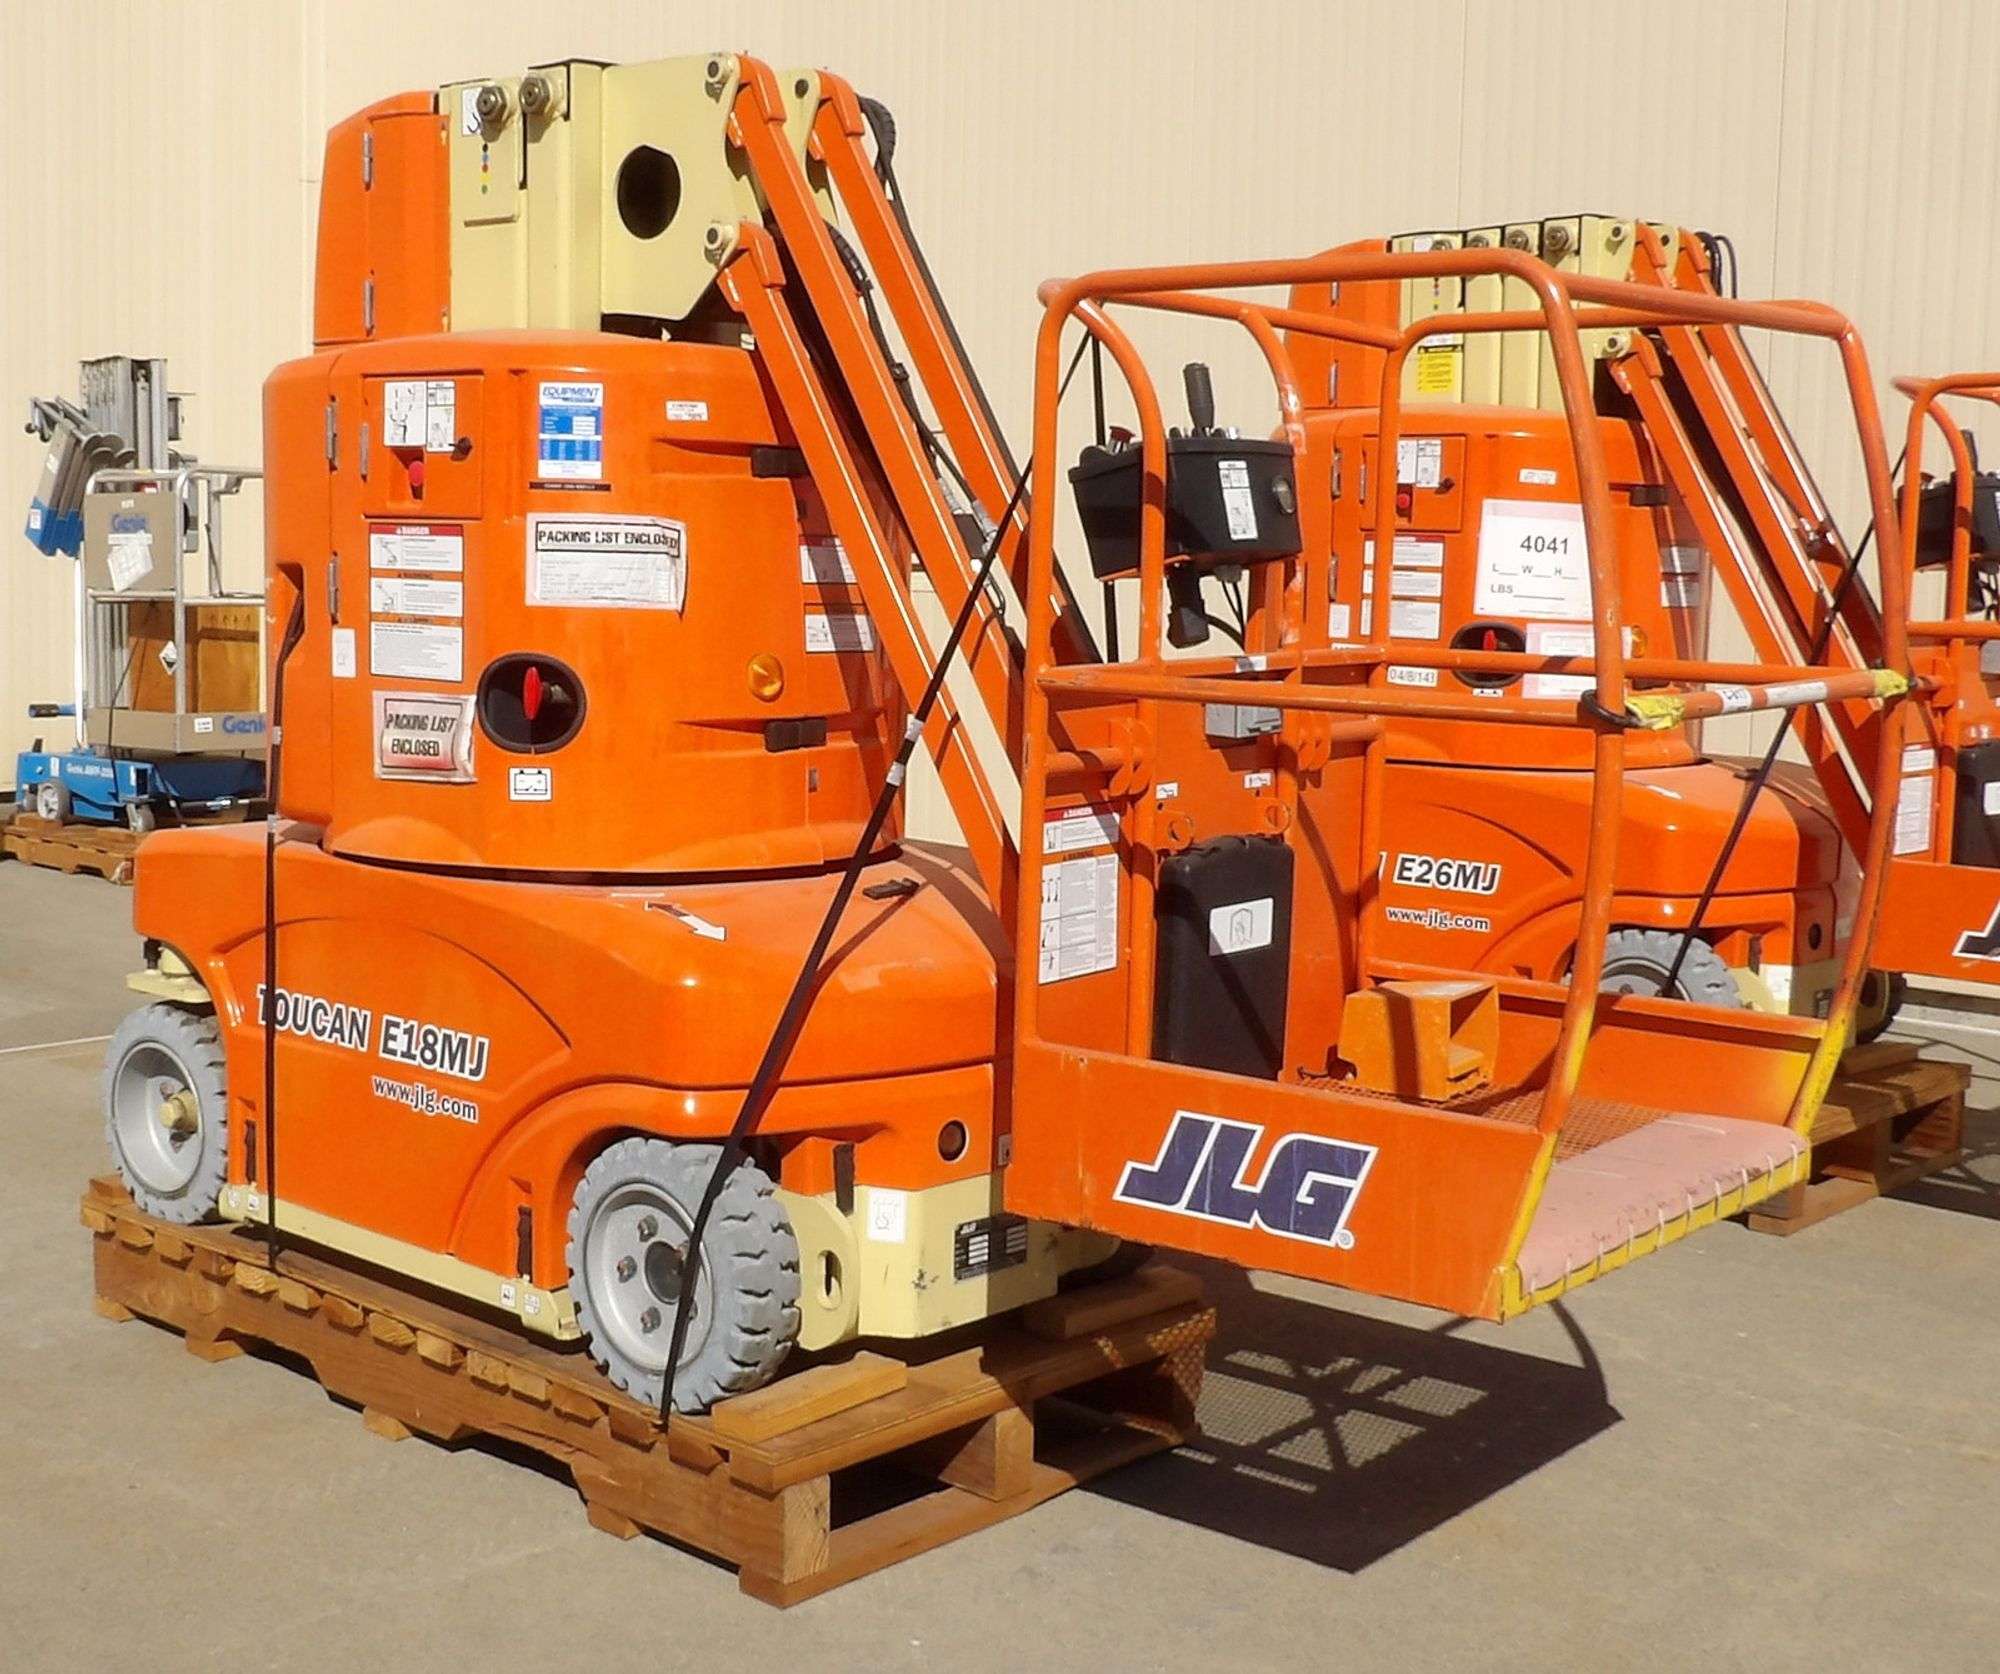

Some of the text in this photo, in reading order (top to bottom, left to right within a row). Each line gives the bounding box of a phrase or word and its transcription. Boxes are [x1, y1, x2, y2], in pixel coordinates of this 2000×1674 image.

[543, 386, 600, 397] EQUIPMENT
[538, 530, 678, 549] PACKING LIST ENCLOSED
[1520, 535, 1569, 555] 4041
[222, 714, 266, 734] Geni
[385, 713, 458, 733] PACKING LIST
[391, 738, 440, 757] ENCLOSED
[1395, 854, 1499, 894] E26MJ
[1387, 907, 1489, 931] www.jlg.com
[380, 1016, 488, 1080] E18MJ
[373, 1077, 480, 1122] www.jlg.com
[1112, 1110, 1379, 1247] JLG
